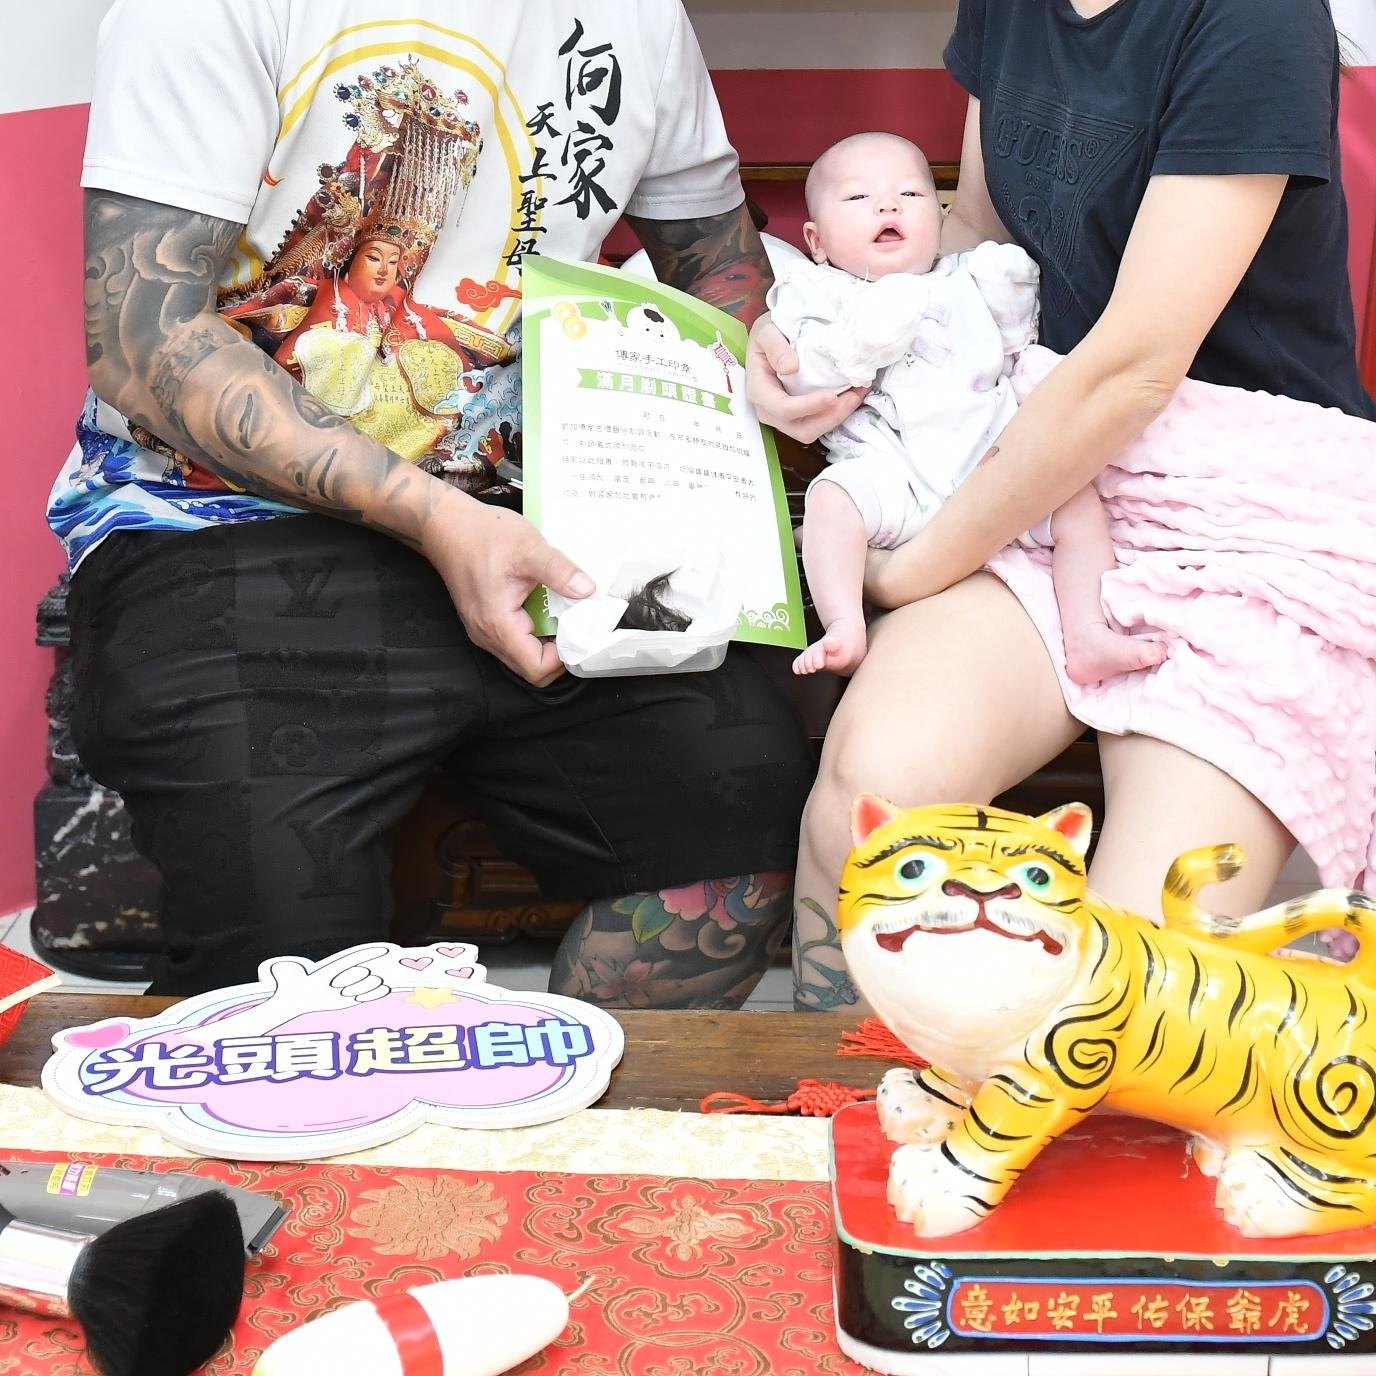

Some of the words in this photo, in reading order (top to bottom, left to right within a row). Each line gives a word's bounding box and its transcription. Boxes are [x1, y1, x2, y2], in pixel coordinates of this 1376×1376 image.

[502, 102, 558, 277] 天上聖母
[558, 17, 622, 220] 何家
[84, 1019, 595, 1096] 光頭超帥
